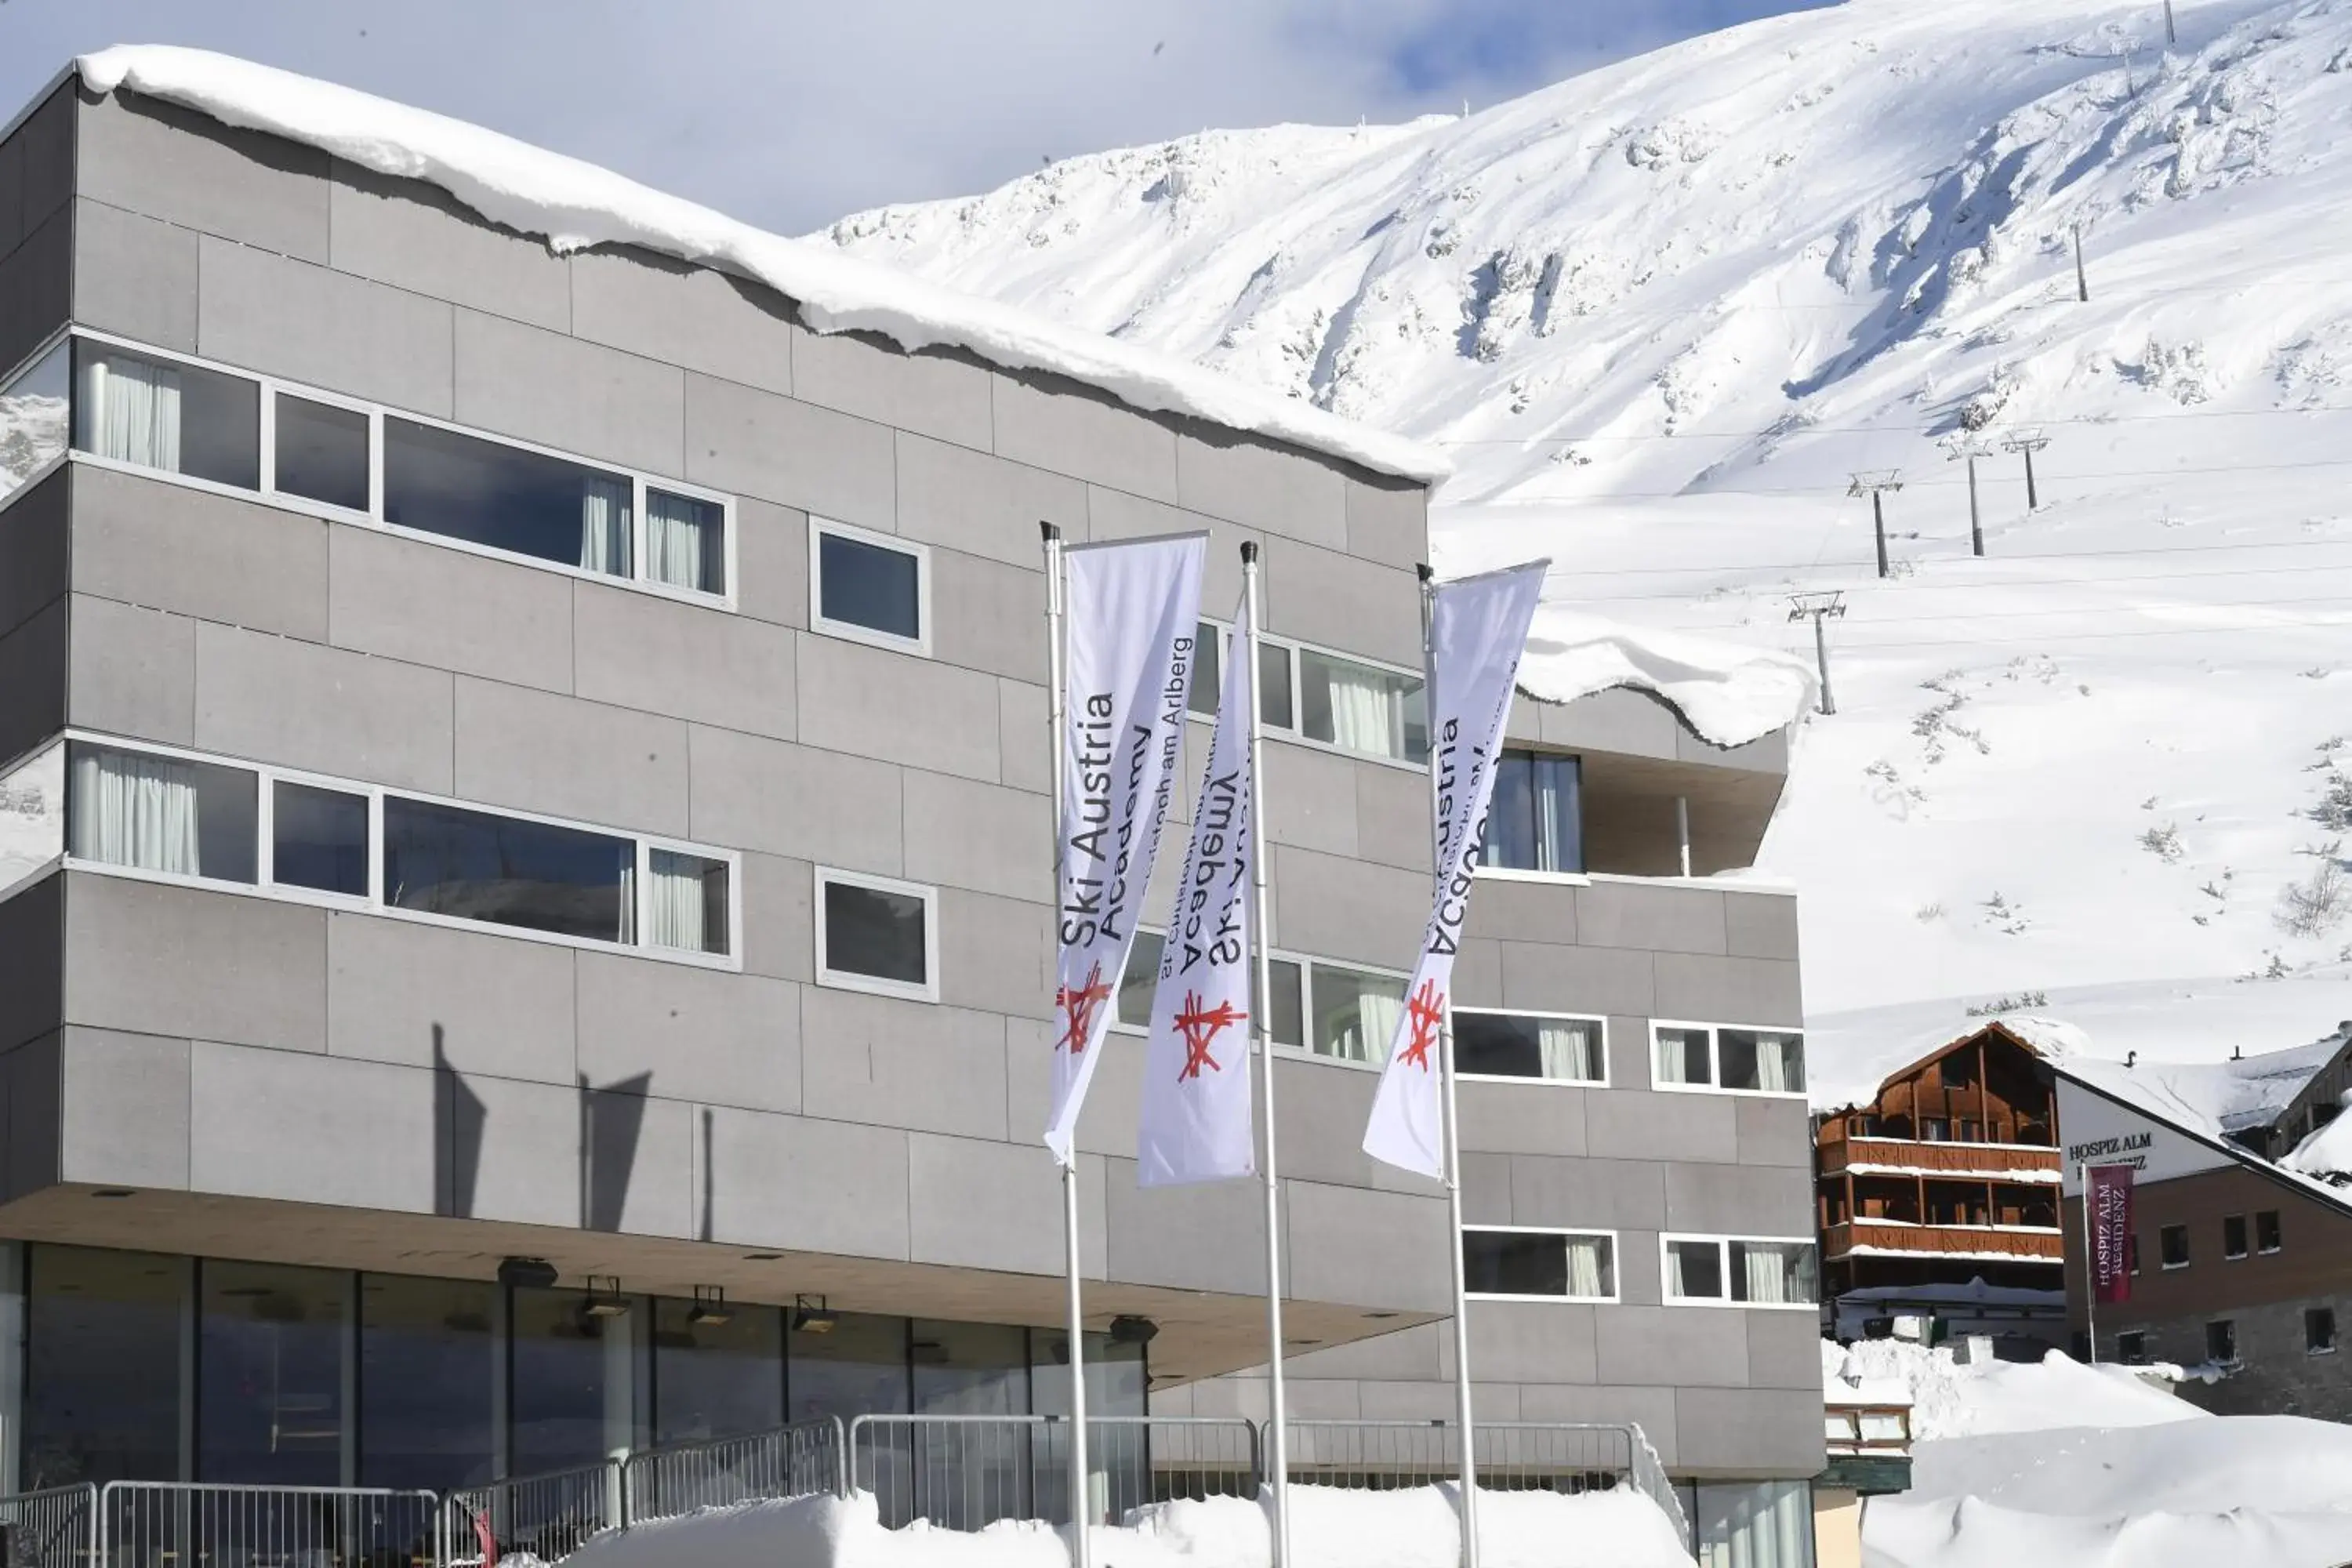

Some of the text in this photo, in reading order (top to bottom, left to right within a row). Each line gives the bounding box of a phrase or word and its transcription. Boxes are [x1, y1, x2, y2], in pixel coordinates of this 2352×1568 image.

[1162, 637, 1193, 726] Arlberg
[1162, 735, 1178, 770] am
[1061, 692, 1112, 948] Ski Austria
[1100, 724, 1152, 942] Academy
[2070, 1133, 2152, 1160] HOSPIZ ALM
[2097, 1183, 2111, 1286] HOSPIZ ALM
[2111, 1187, 2125, 1276] RESIDENZ
